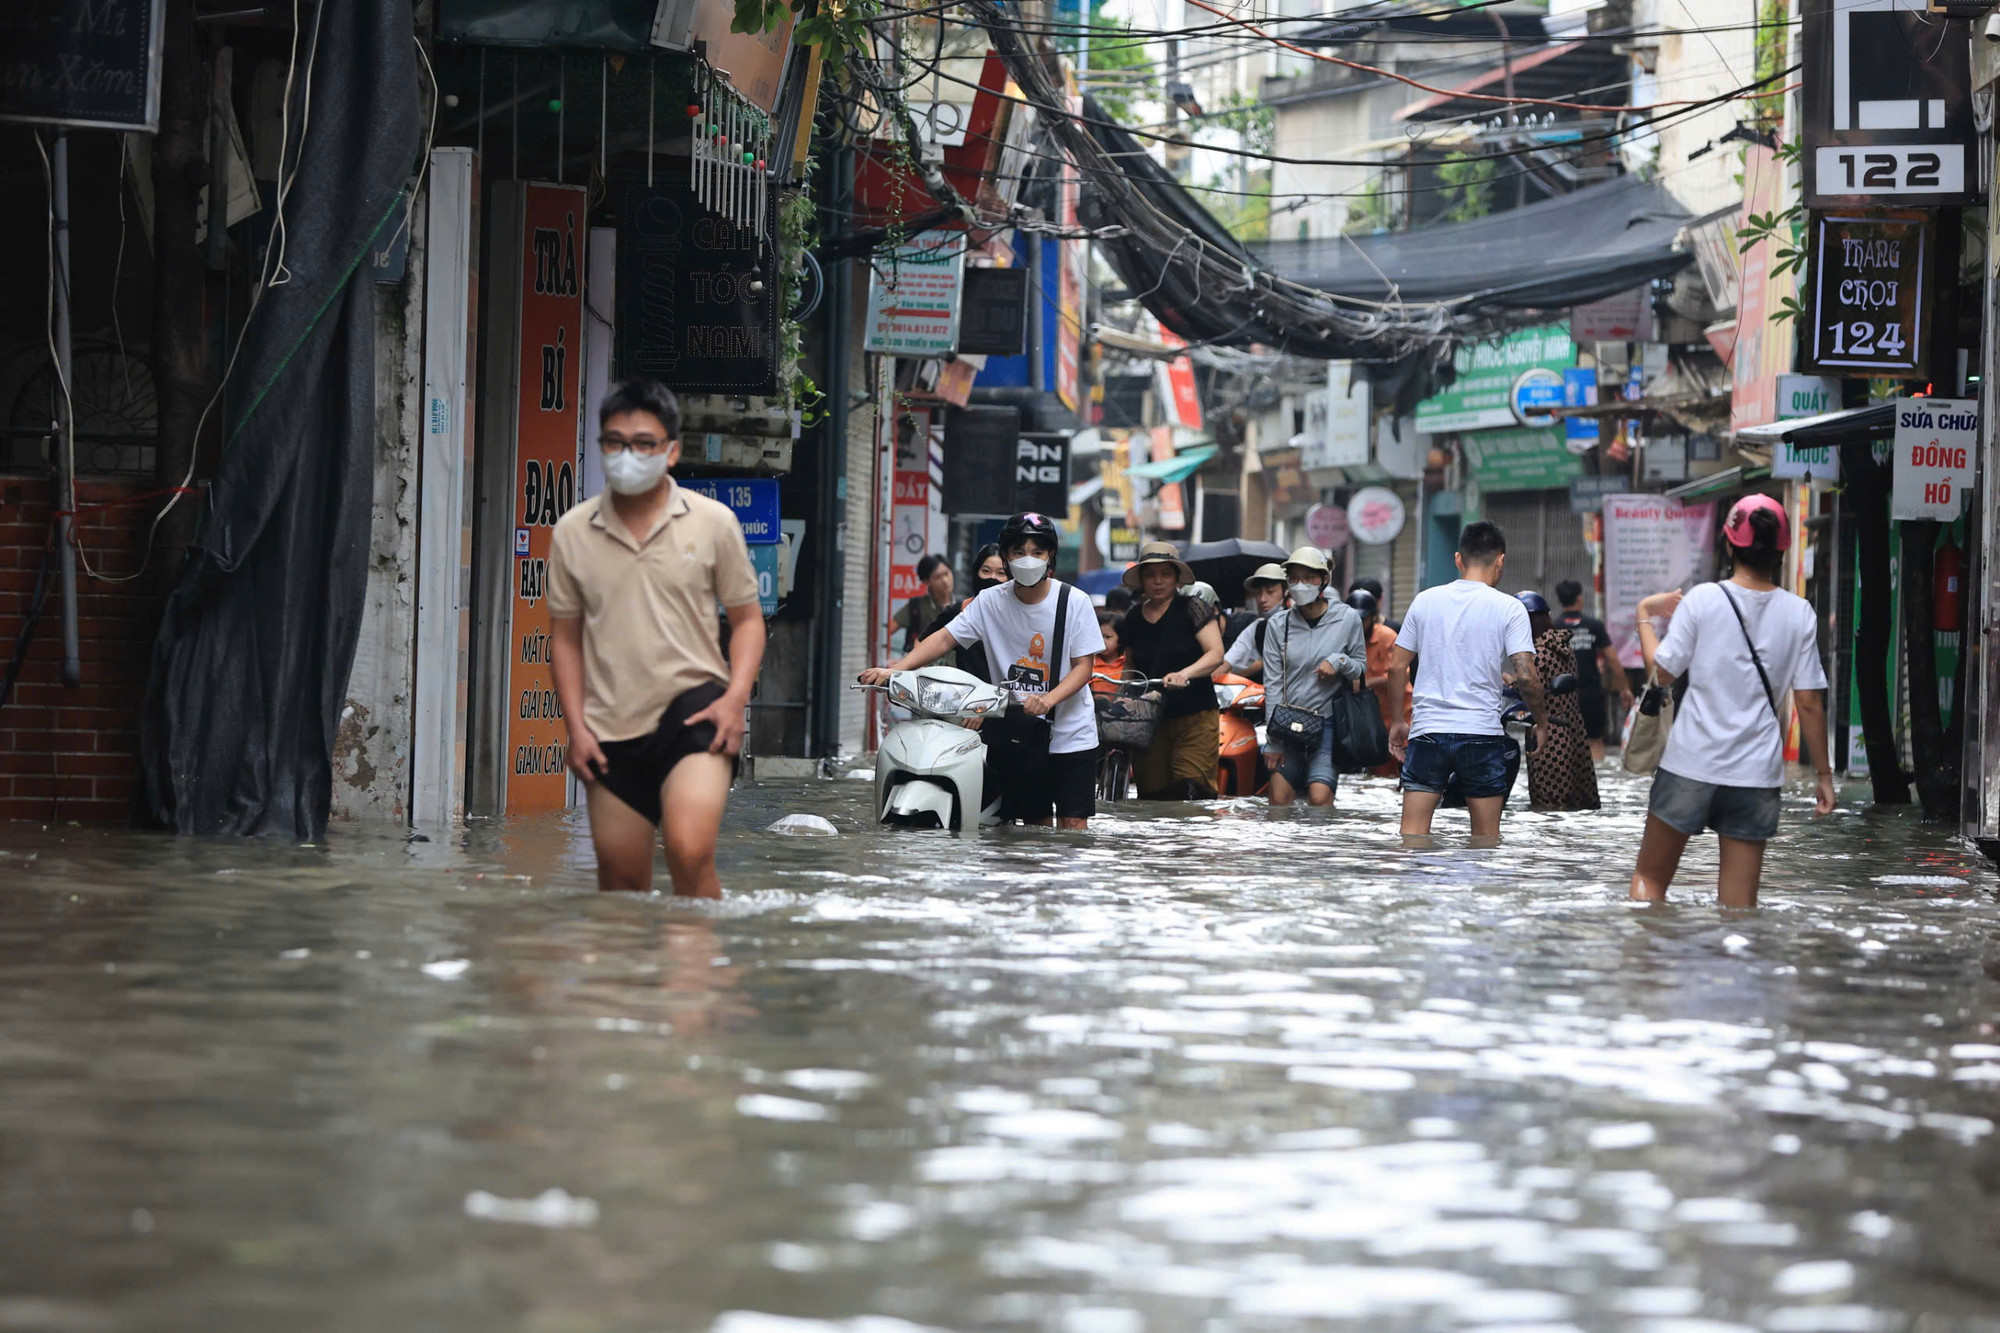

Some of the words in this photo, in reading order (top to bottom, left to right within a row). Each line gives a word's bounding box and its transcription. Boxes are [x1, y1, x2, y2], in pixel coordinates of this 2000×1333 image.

[1839, 153, 1940, 188] 122
[533, 211, 578, 296] TRÀ
[689, 262, 762, 305] TÓC
[686, 325, 761, 358] NAM
[1828, 320, 1905, 356] 124
[540, 325, 565, 411] BÍ
[1900, 405, 1933, 429] SỬA
[1911, 437, 1966, 469] ĐỒNG
[523, 459, 576, 527] ĐAO
[728, 486, 752, 508] 135
[1924, 475, 1952, 504] HỒ
[1615, 506, 1661, 522] Beauty
[520, 558, 545, 607] HẠT
[521, 627, 545, 664] MÁT
[520, 680, 541, 720] GIẢI
[515, 736, 543, 775] GIẢM
[543, 737, 567, 775] CÂN
